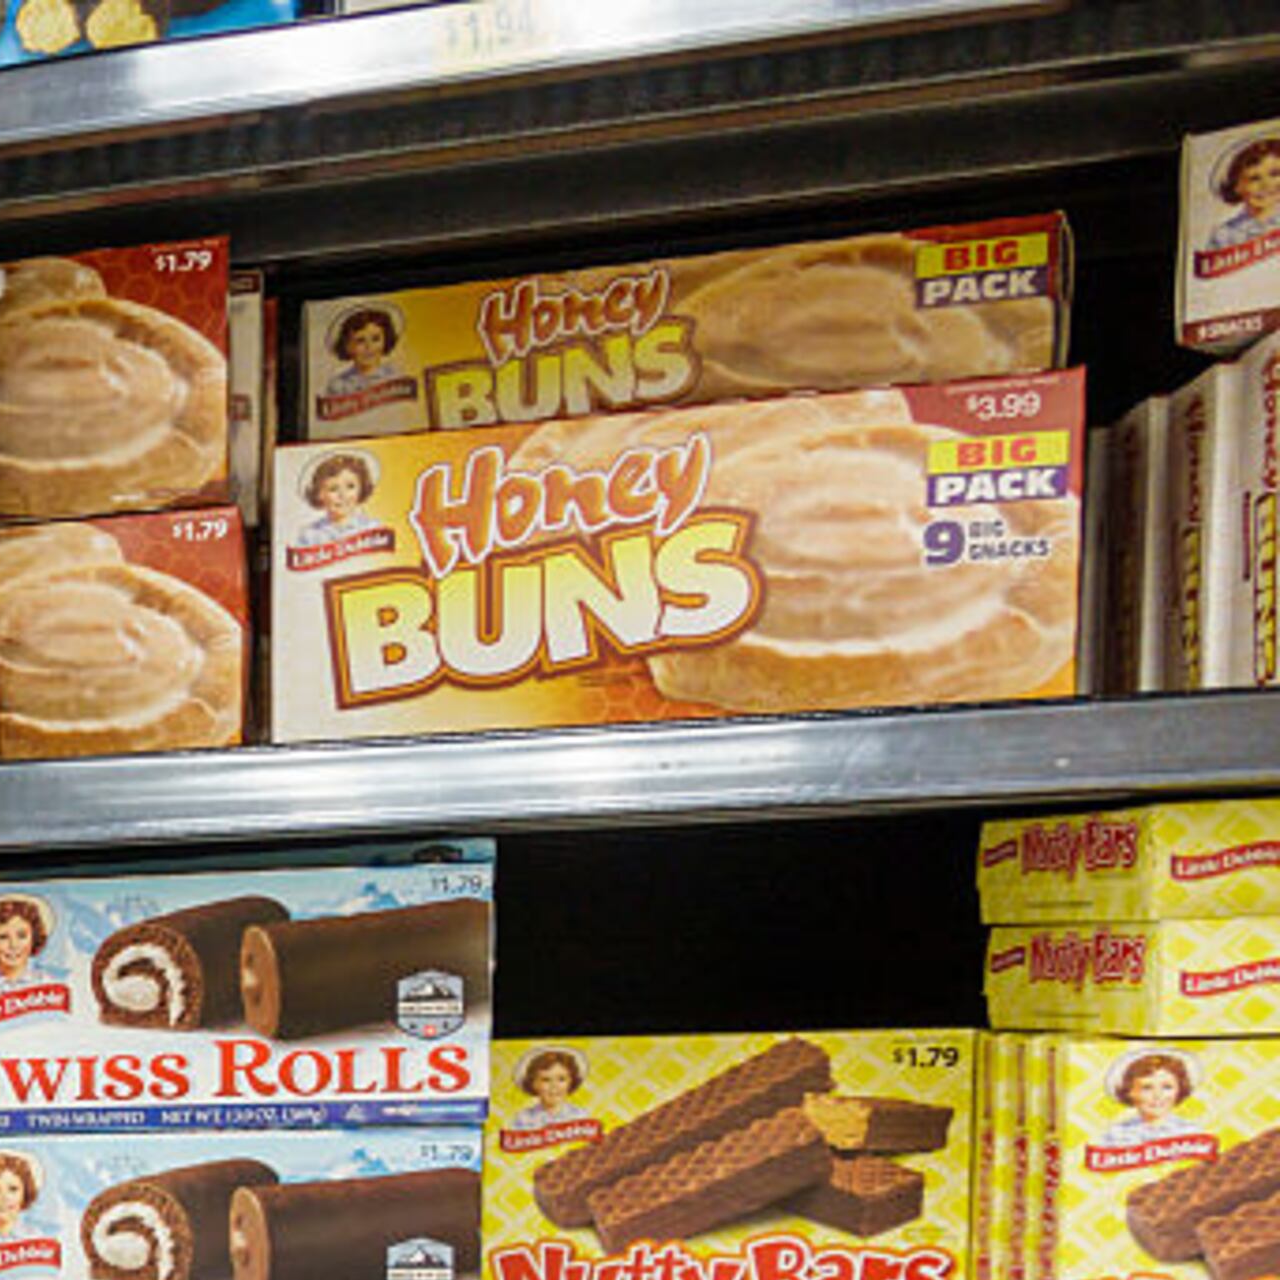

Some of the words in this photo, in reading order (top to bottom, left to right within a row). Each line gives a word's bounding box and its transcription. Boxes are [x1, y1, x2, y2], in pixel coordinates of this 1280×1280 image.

[154, 250, 213, 272] $1.79
[943, 242, 1020, 270] BIG
[922, 272, 1039, 306] PACK
[480, 270, 669, 366] Honey
[428, 328, 693, 430] BUNS
[966, 390, 1042, 421] $3.99
[956, 438, 1037, 467] BIG
[415, 433, 711, 572] Honey
[934, 469, 1058, 503] PACK
[172, 519, 228, 542] $1.79
[923, 521, 966, 564] 9
[290, 538, 343, 567] Little
[345, 530, 394, 557] Debbie
[337, 520, 754, 694] BUNS
[6, 988, 68, 1015] Debbie
[213, 1040, 472, 1099] ROLLS
[892, 1047, 960, 1069] $1.79
[421, 1143, 474, 1162] $1.79
[1090, 1146, 1140, 1170] Little
[1143, 1138, 1214, 1161] Debbie
